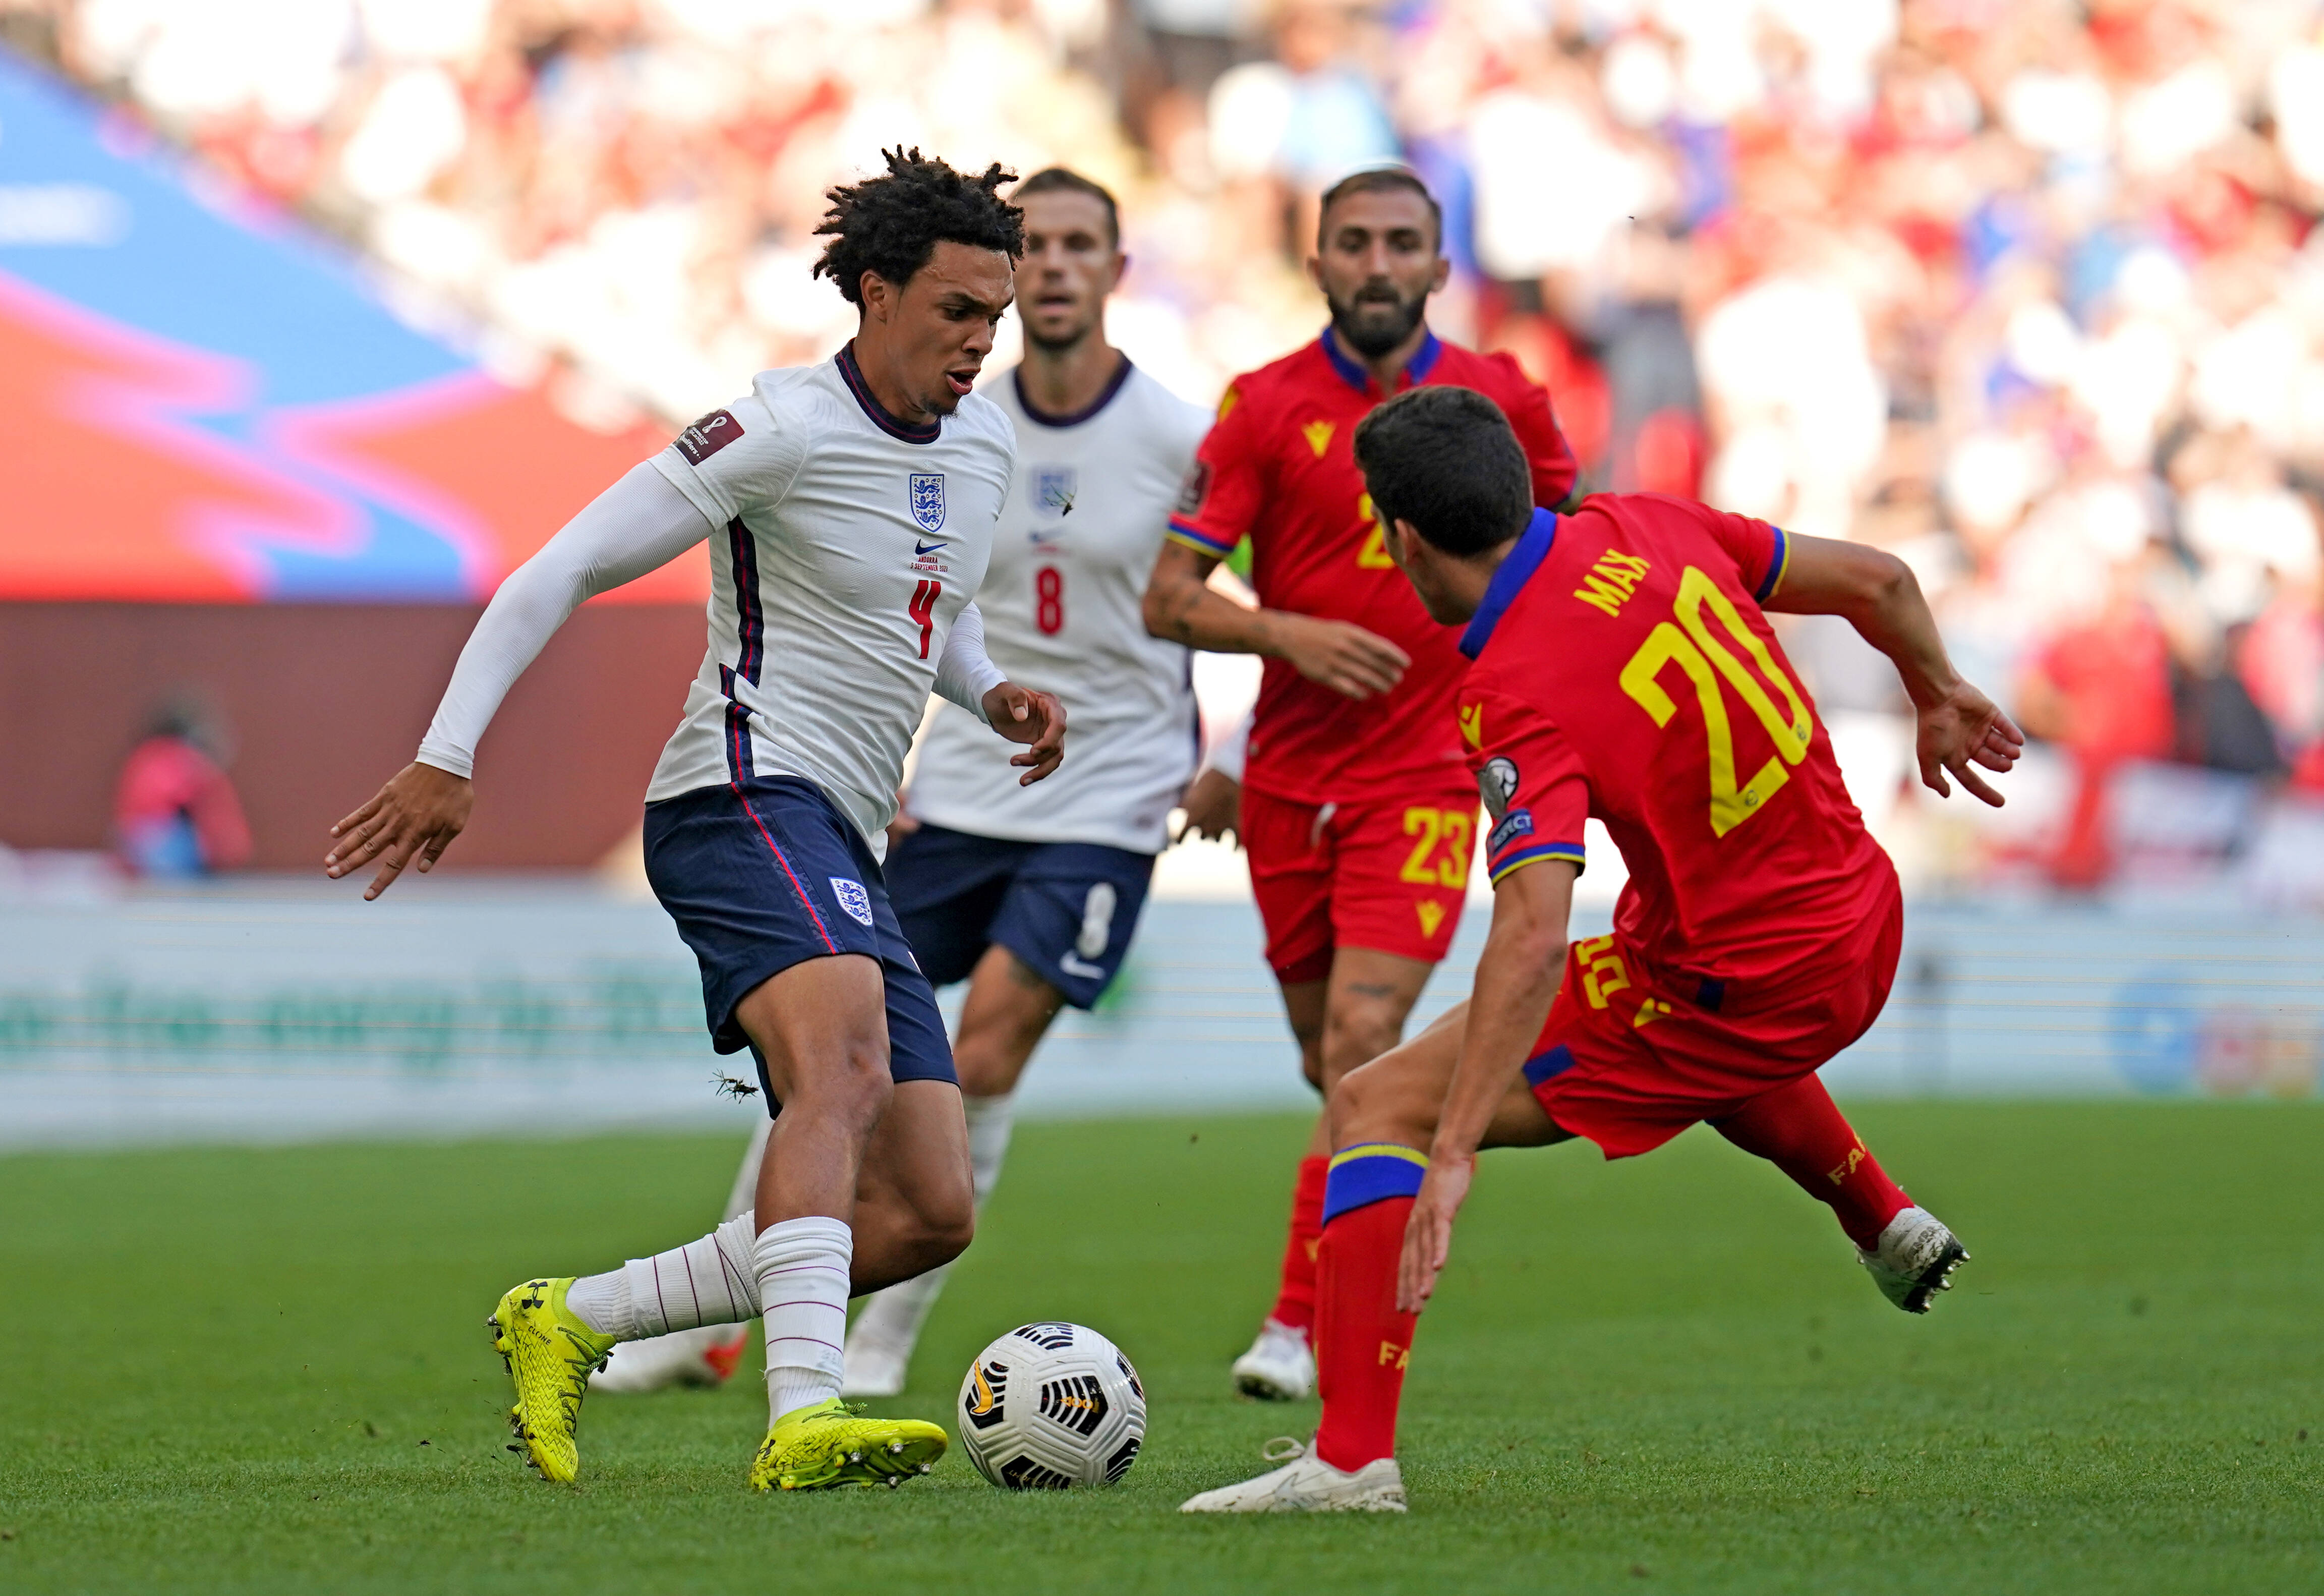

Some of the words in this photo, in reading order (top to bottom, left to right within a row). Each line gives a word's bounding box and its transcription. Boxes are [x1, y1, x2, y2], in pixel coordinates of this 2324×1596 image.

[914, 563, 938, 571] SEPTEMBER
[1357, 492, 1396, 569] 2
[909, 580, 941, 659] 4
[1036, 566, 1063, 636] 8
[1574, 548, 1651, 618] MAX
[1619, 565, 1813, 838] 20
[1400, 807, 1469, 889] 23
[1075, 882, 1117, 959] 8
[528, 1326, 552, 1345] CLONE
